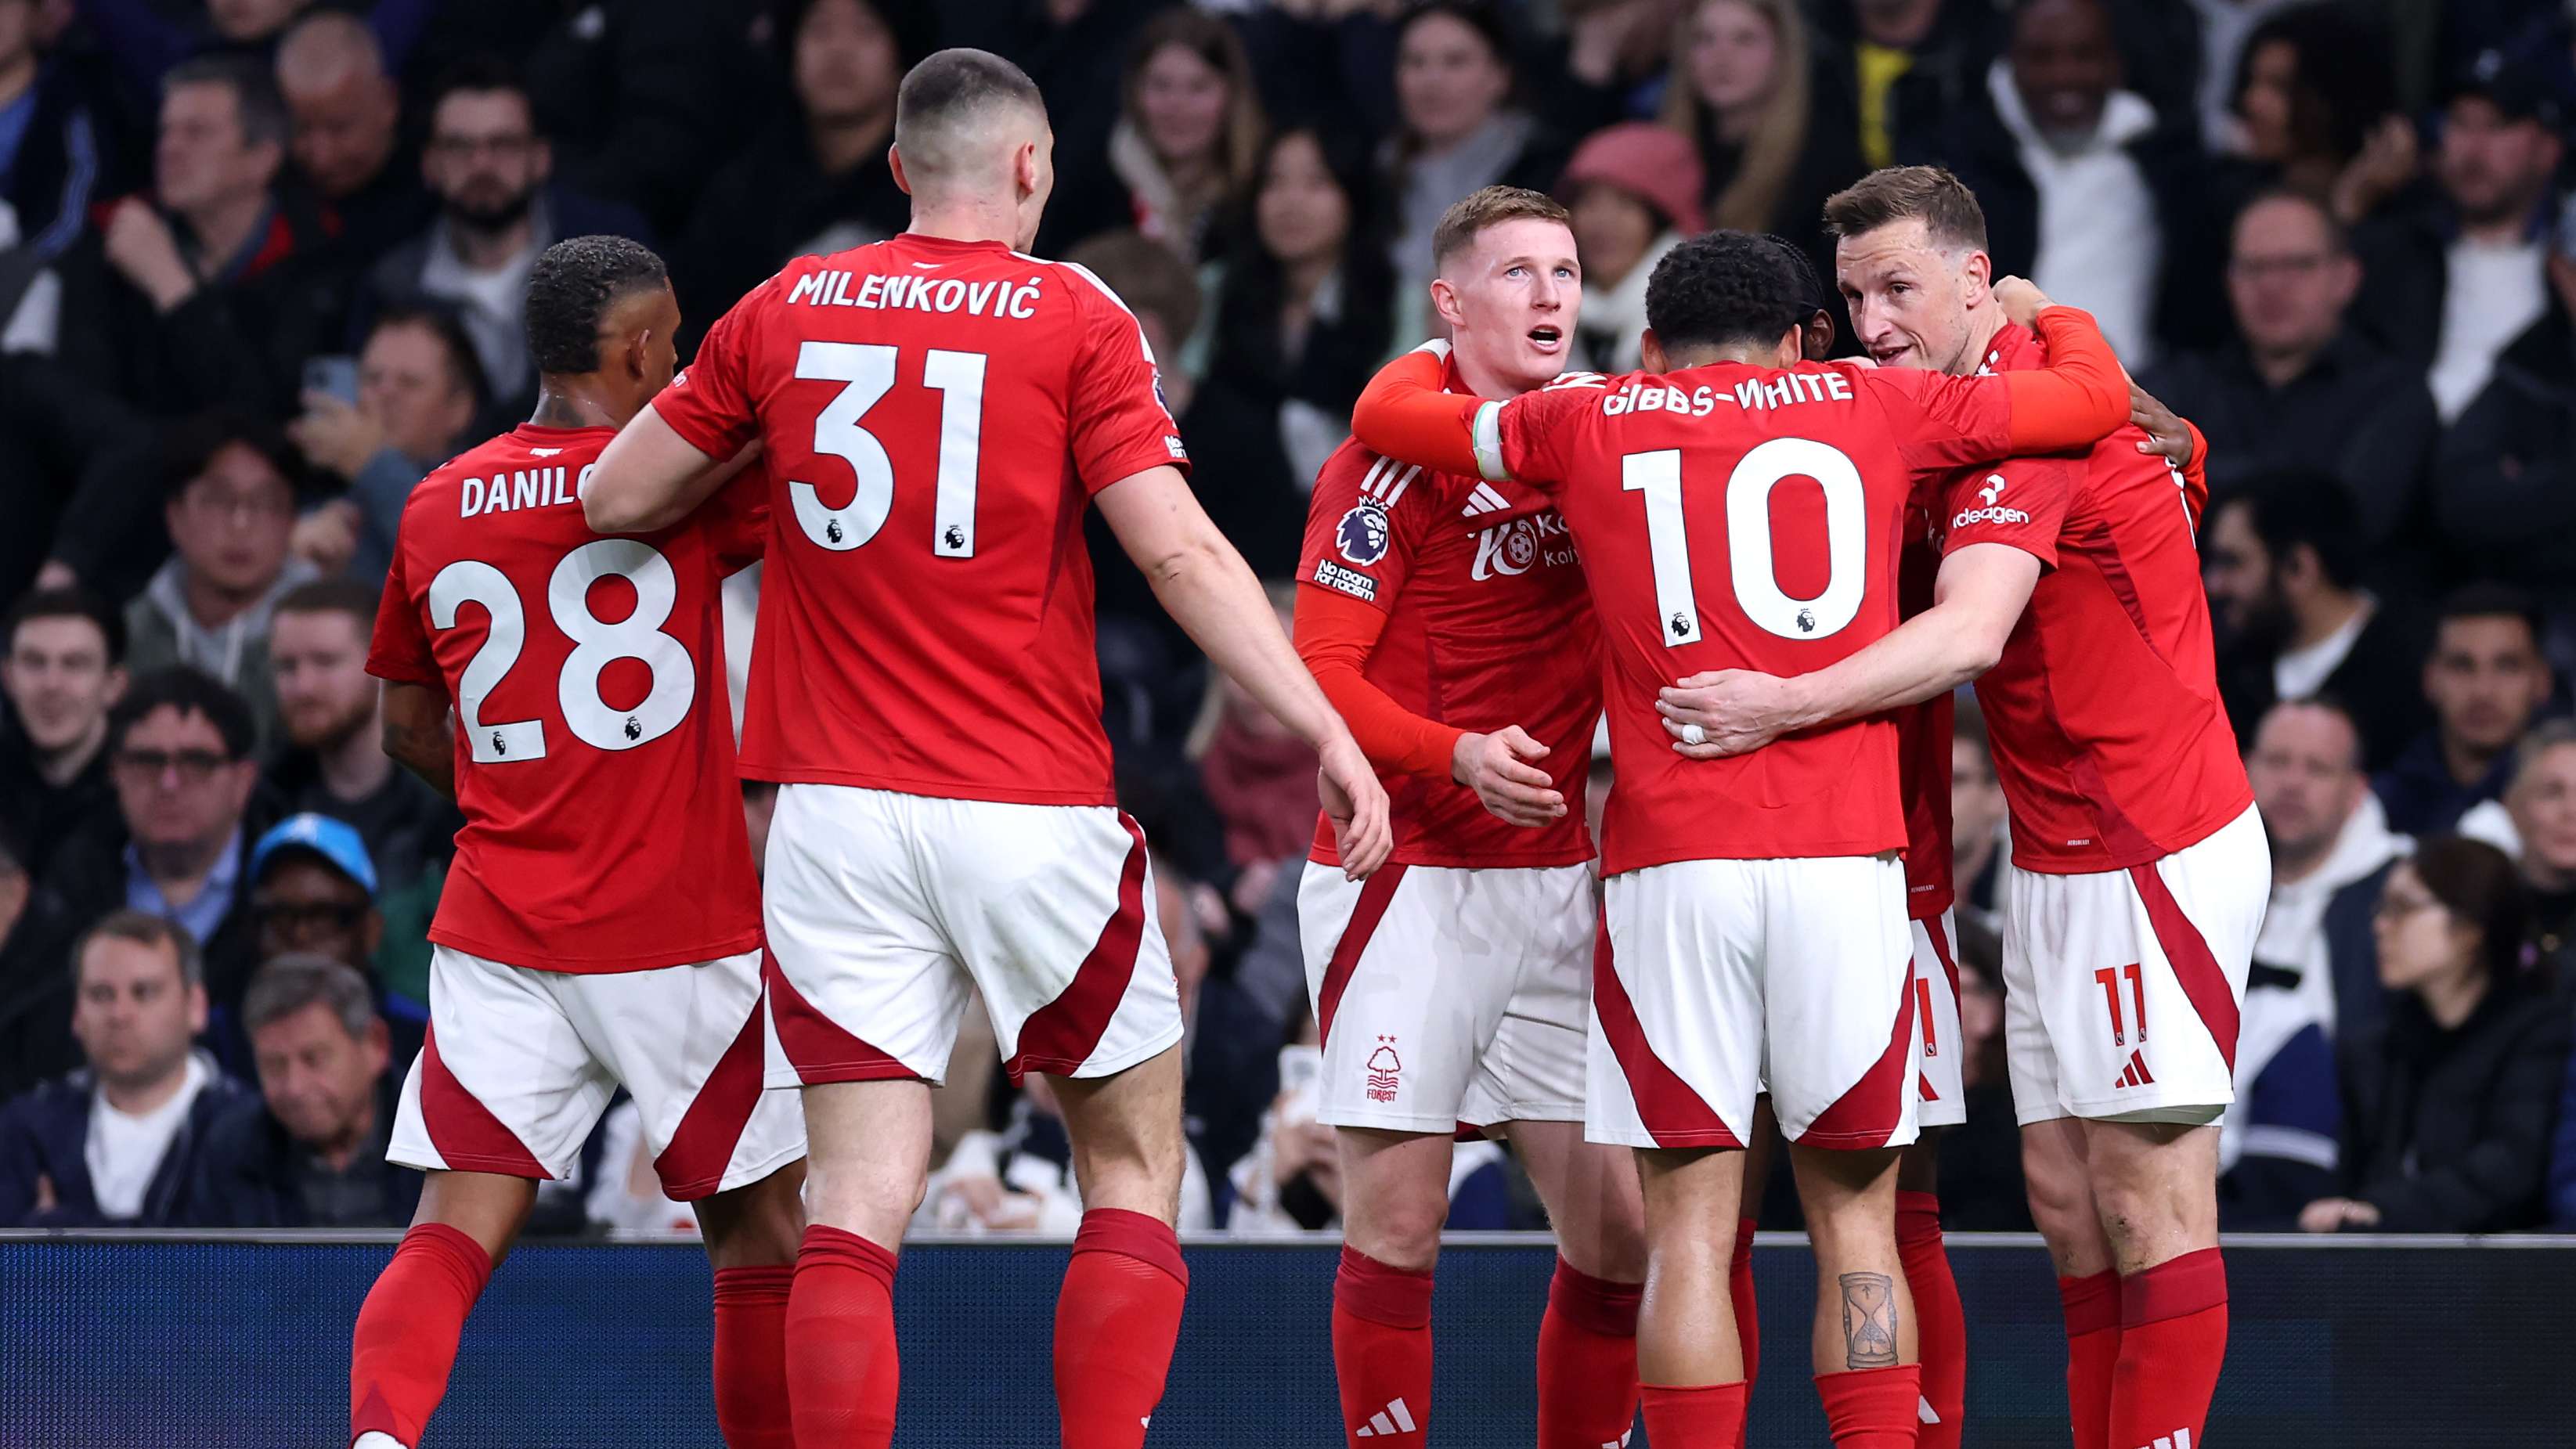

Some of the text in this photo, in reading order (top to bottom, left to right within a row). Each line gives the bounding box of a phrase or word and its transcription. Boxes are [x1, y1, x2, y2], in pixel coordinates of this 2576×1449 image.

[787, 269, 1042, 319] MILENKOVIĆ
[1603, 372, 1854, 416] GIBBS-WHITE
[788, 341, 988, 557] 31
[1622, 437, 1867, 648] 10
[1952, 506, 2029, 529] ideagen
[1314, 571, 1375, 602] for racism
[1317, 559, 1373, 589] No room
[428, 538, 696, 763] 28
[2094, 963, 2147, 1047] 11
